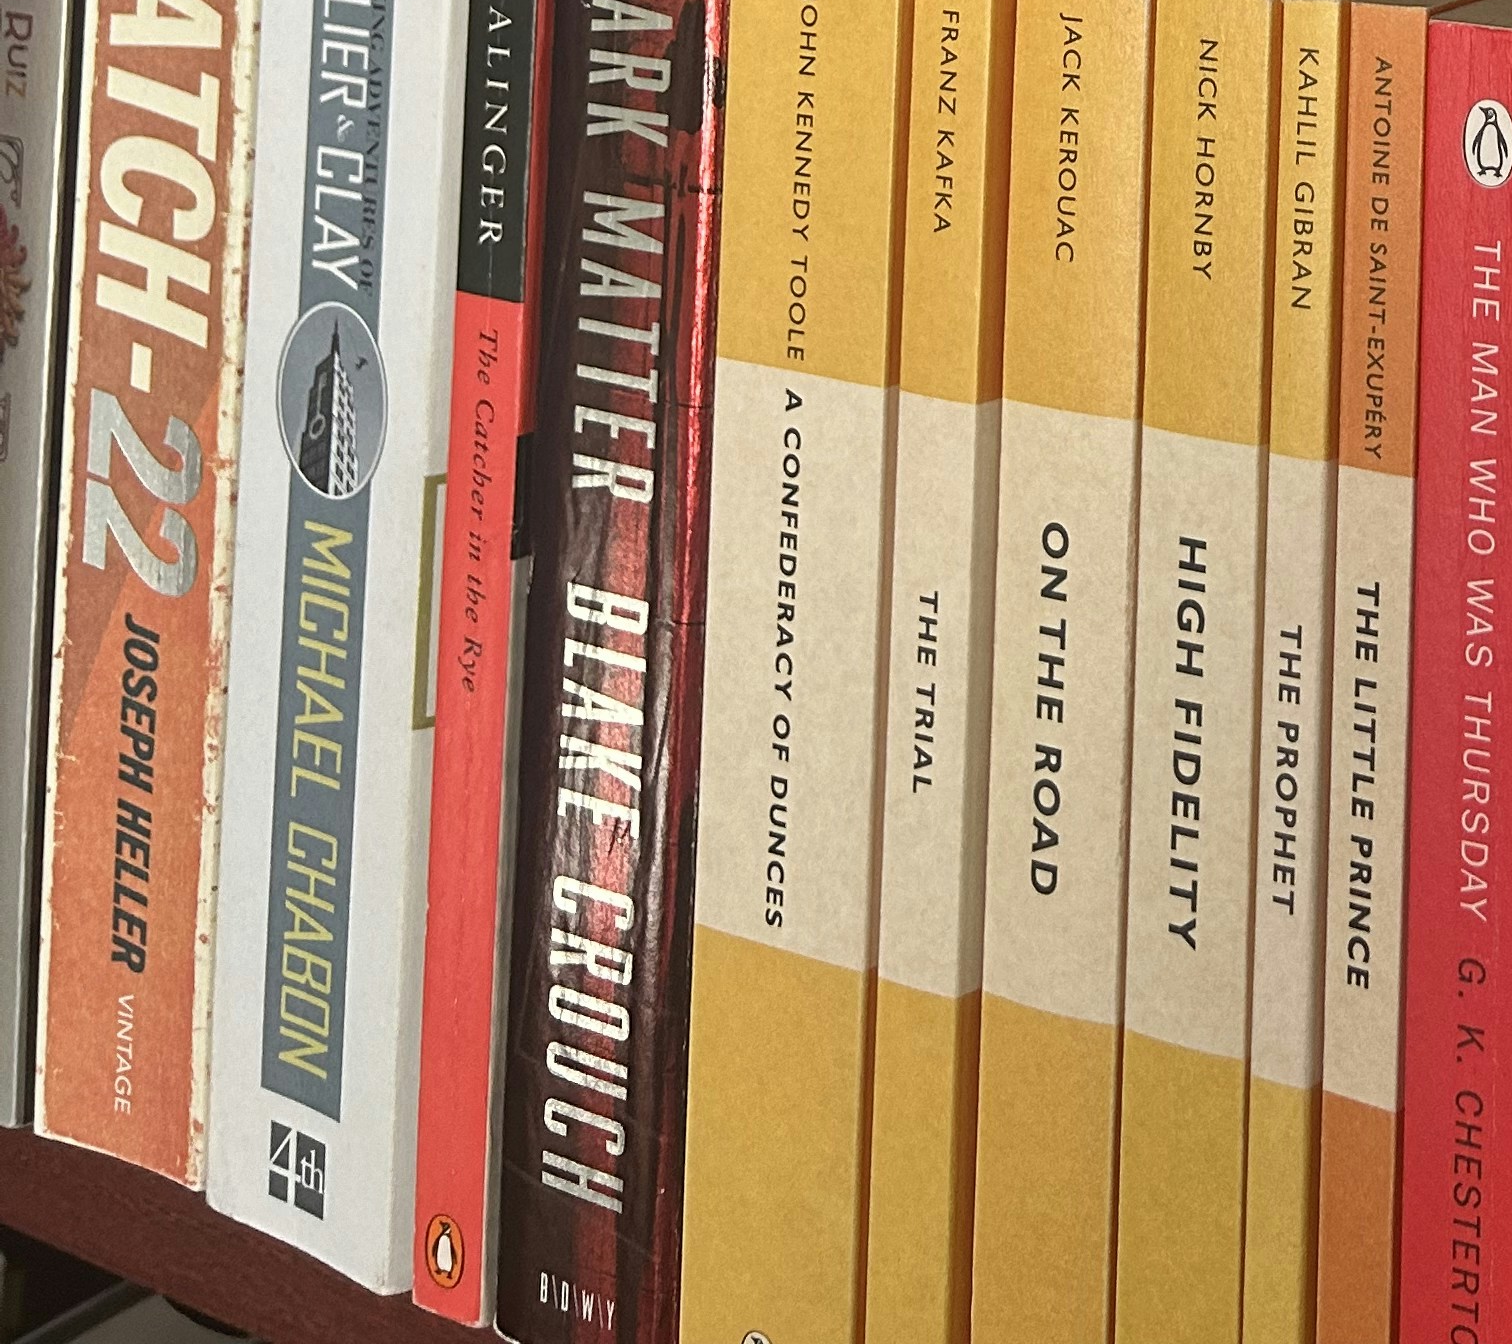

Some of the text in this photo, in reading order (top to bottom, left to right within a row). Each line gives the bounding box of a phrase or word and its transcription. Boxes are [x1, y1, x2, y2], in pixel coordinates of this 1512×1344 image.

[4, 12, 34, 100] RUIZ
[336, 115, 358, 144] &
[933, 8, 960, 234] FRANZ KAFKA
[1192, 37, 1219, 281] NICK HORNBY
[1290, 46, 1320, 312] KAHLIL GIBRAN
[310, 145, 365, 292] CLAY
[571, 189, 667, 505] MATTER
[457, 328, 498, 694] The Catcher in the Rye
[111, 611, 161, 975] JOSEPH HELLER
[557, 579, 651, 841] BLAKE
[911, 589, 940, 797] THE TRIAL
[1030, 520, 1070, 897] ON THE ROAD
[1168, 535, 1208, 951] HIGH FIDELITY
[1271, 623, 1304, 917] THE PROPHET
[113, 994, 136, 1116] VINTAGE
[540, 874, 636, 1215] CROUCH
